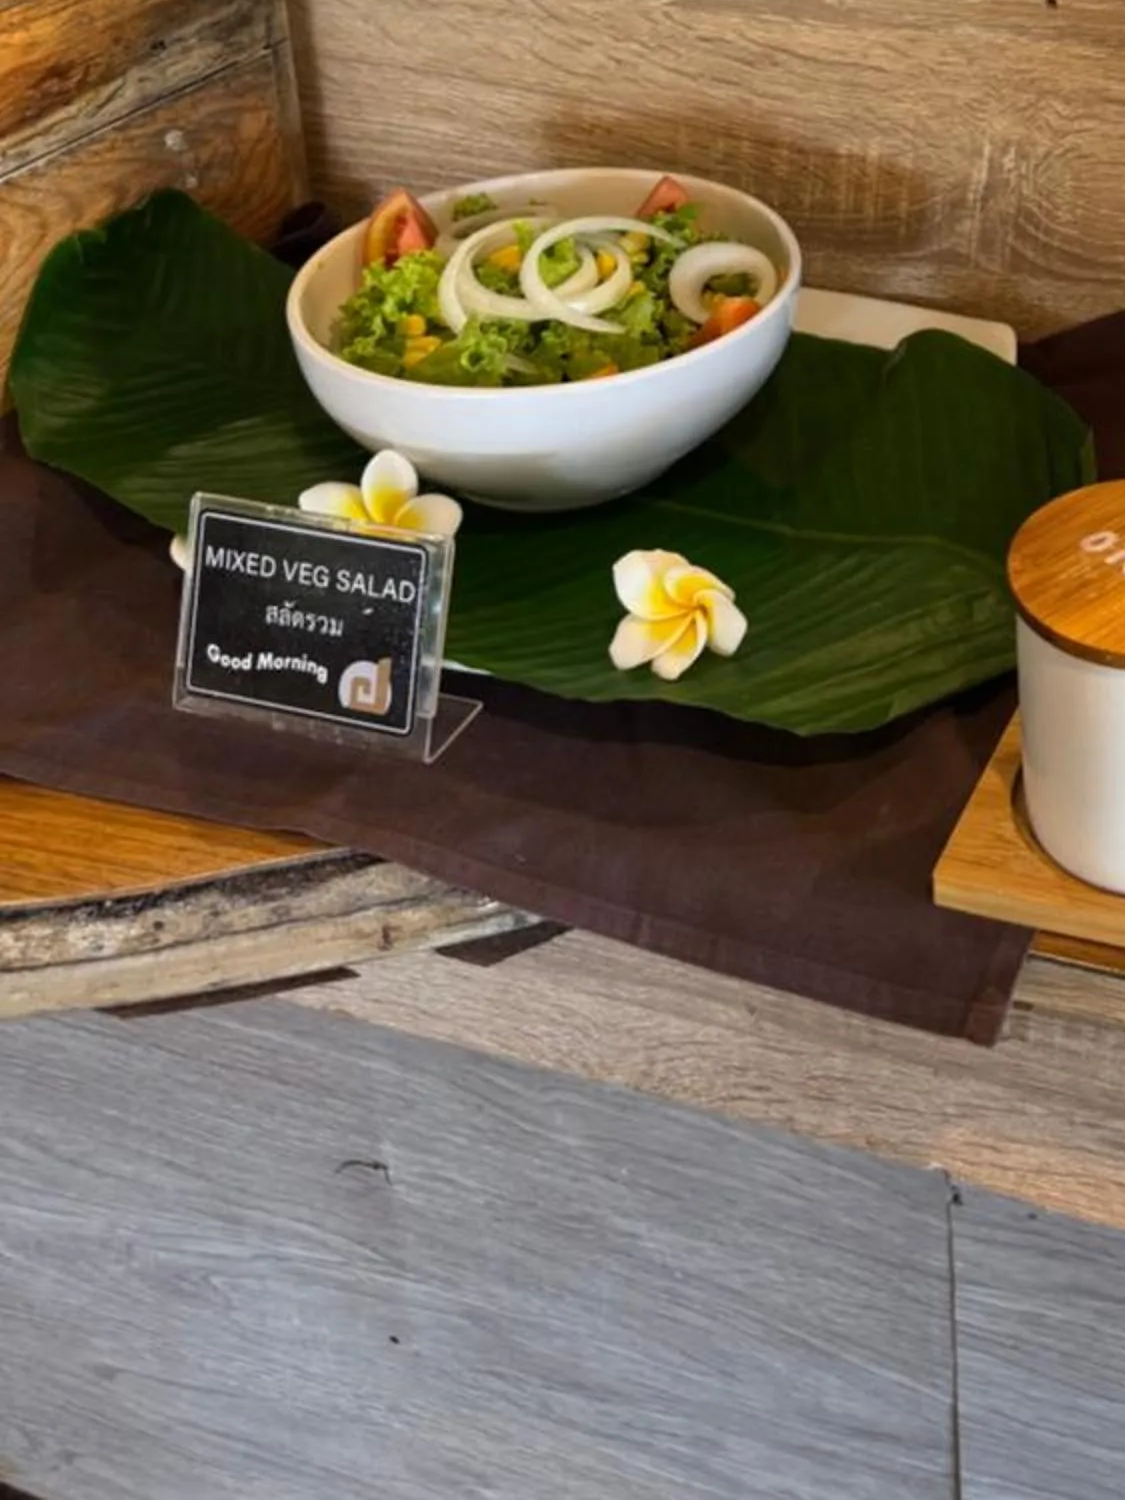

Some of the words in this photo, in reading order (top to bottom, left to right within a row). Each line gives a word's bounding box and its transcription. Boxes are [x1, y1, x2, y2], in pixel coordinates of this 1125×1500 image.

[205, 546, 277, 578] MIXED
[283, 560, 330, 588] VEG
[336, 569, 416, 603] SALAD
[264, 600, 344, 637] สลัดรวม
[207, 643, 252, 670] Good
[256, 652, 329, 684] Morning
